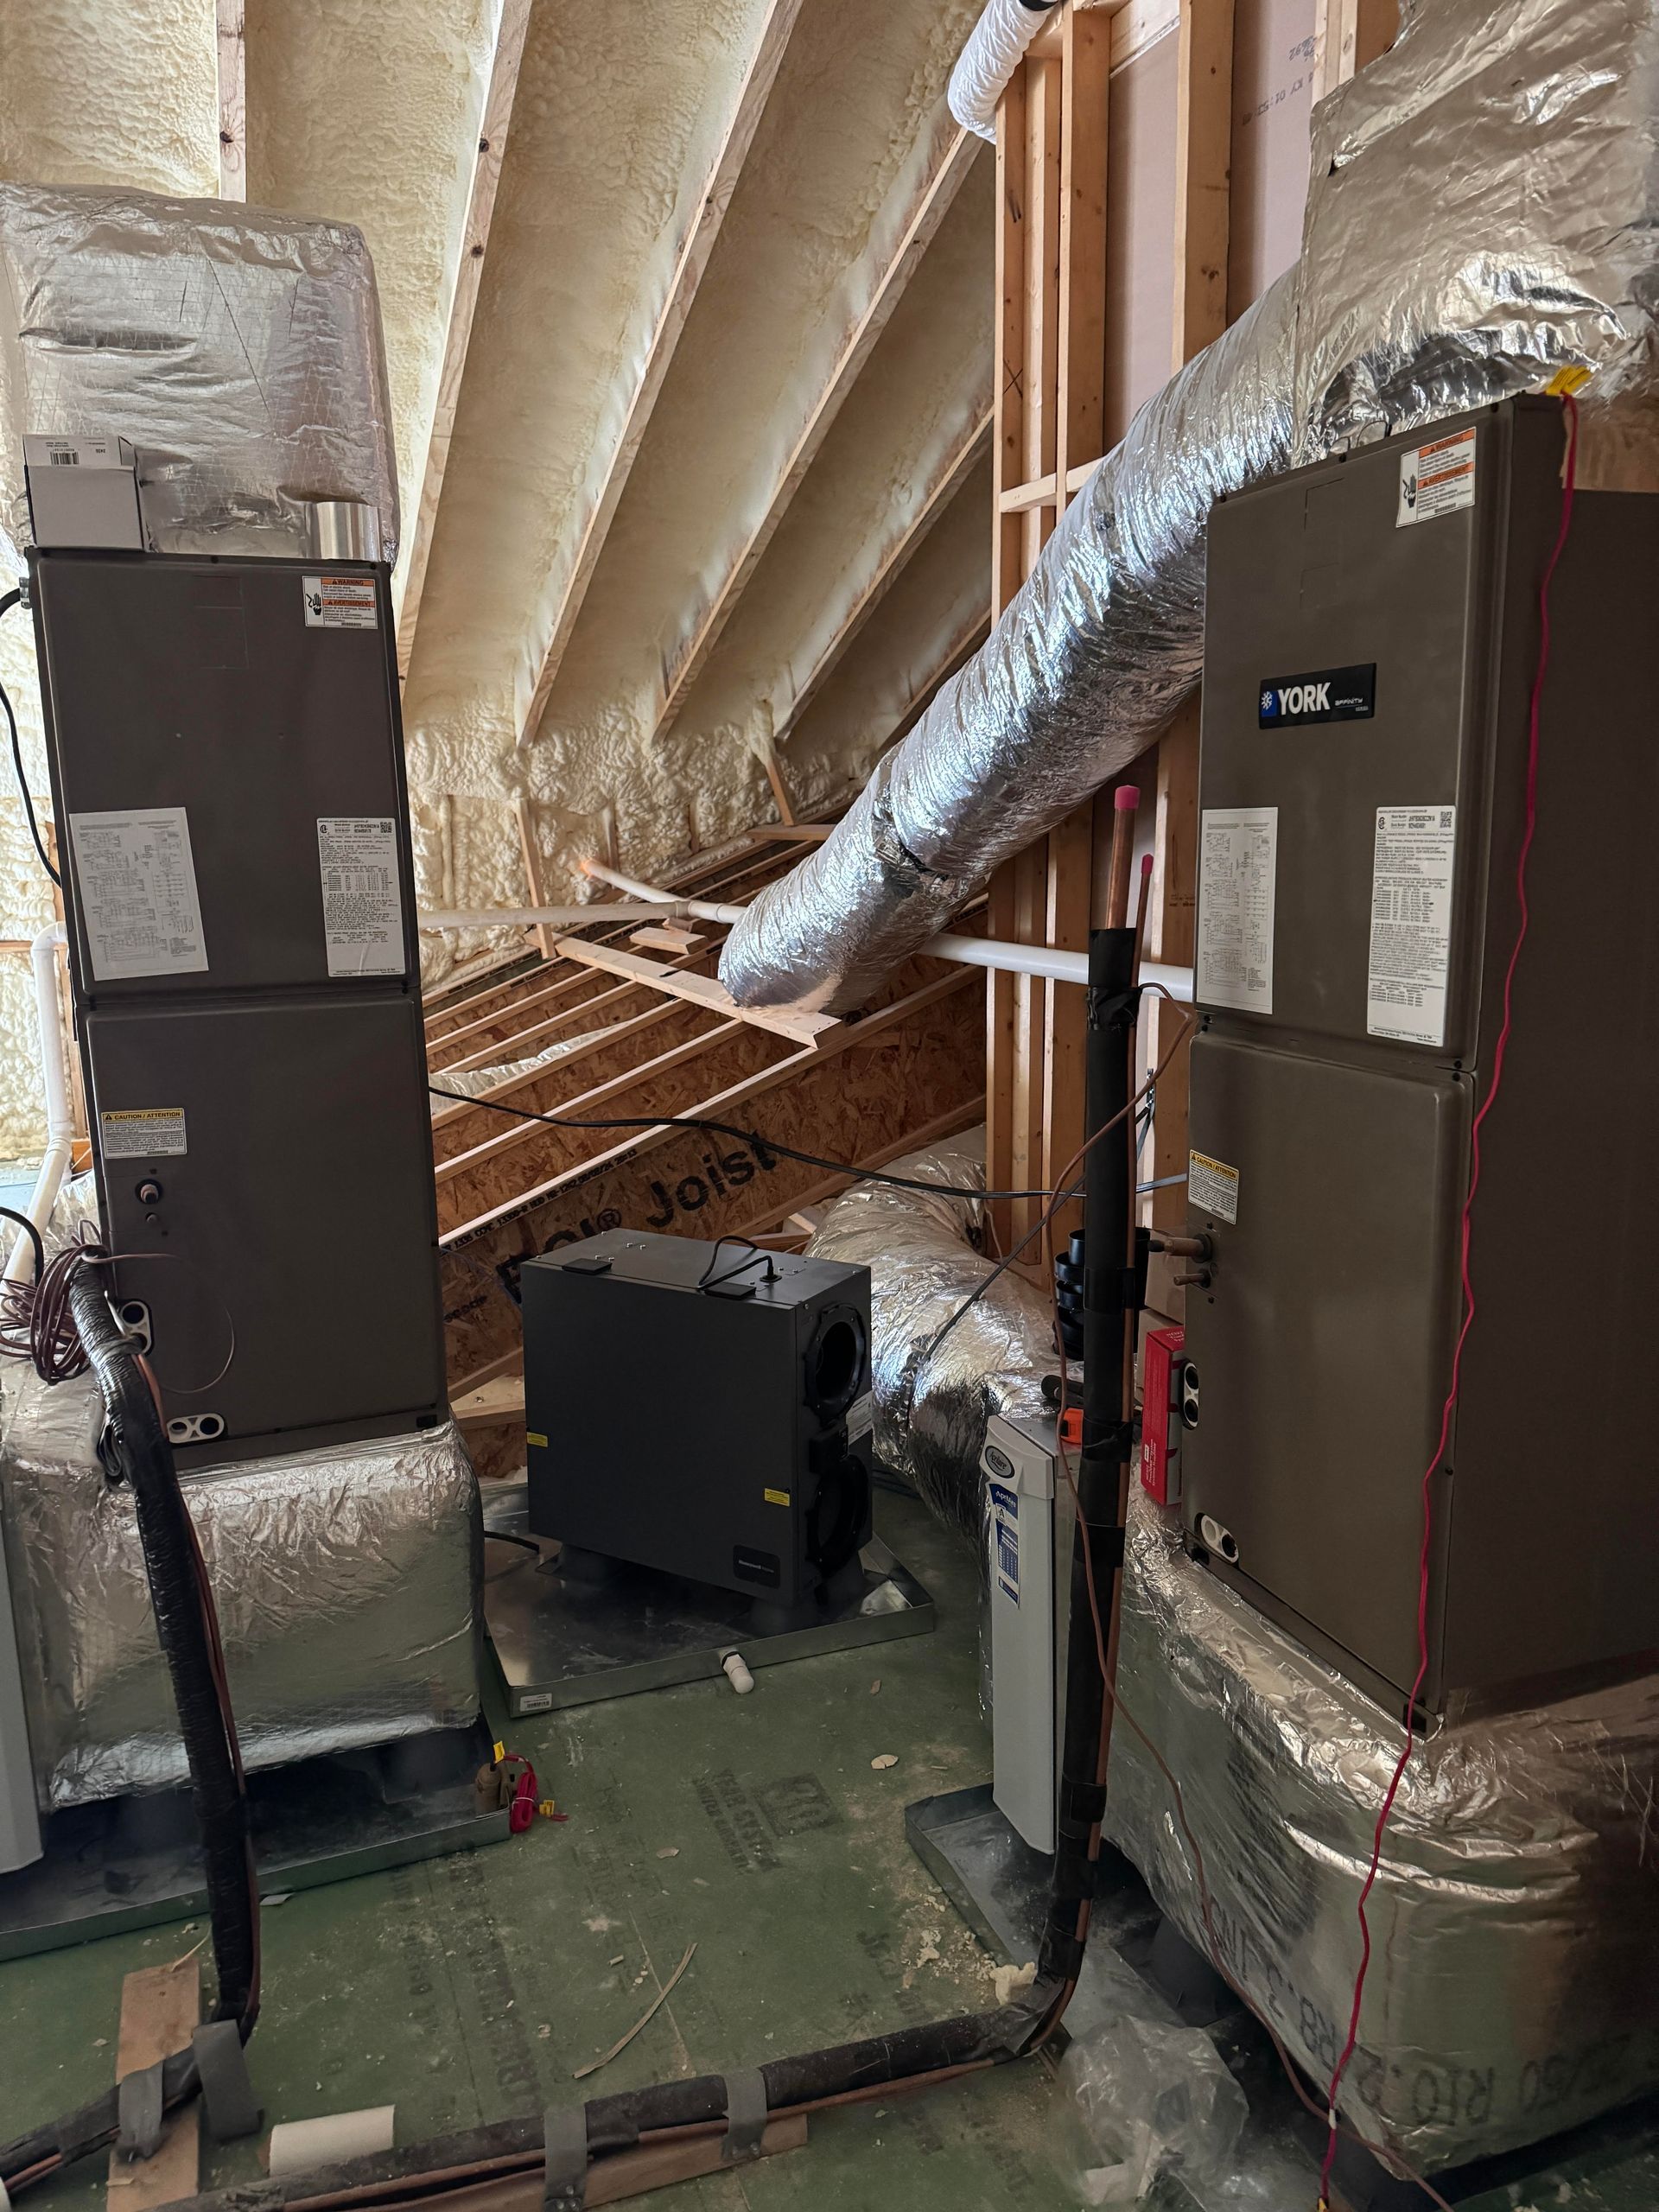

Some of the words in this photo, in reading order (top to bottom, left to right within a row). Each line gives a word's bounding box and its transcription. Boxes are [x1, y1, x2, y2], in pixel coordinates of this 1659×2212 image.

[1277, 682, 1332, 715] YORK
[646, 1128, 778, 1229] Joist
[1196, 1155, 1213, 1169] CAUTION
